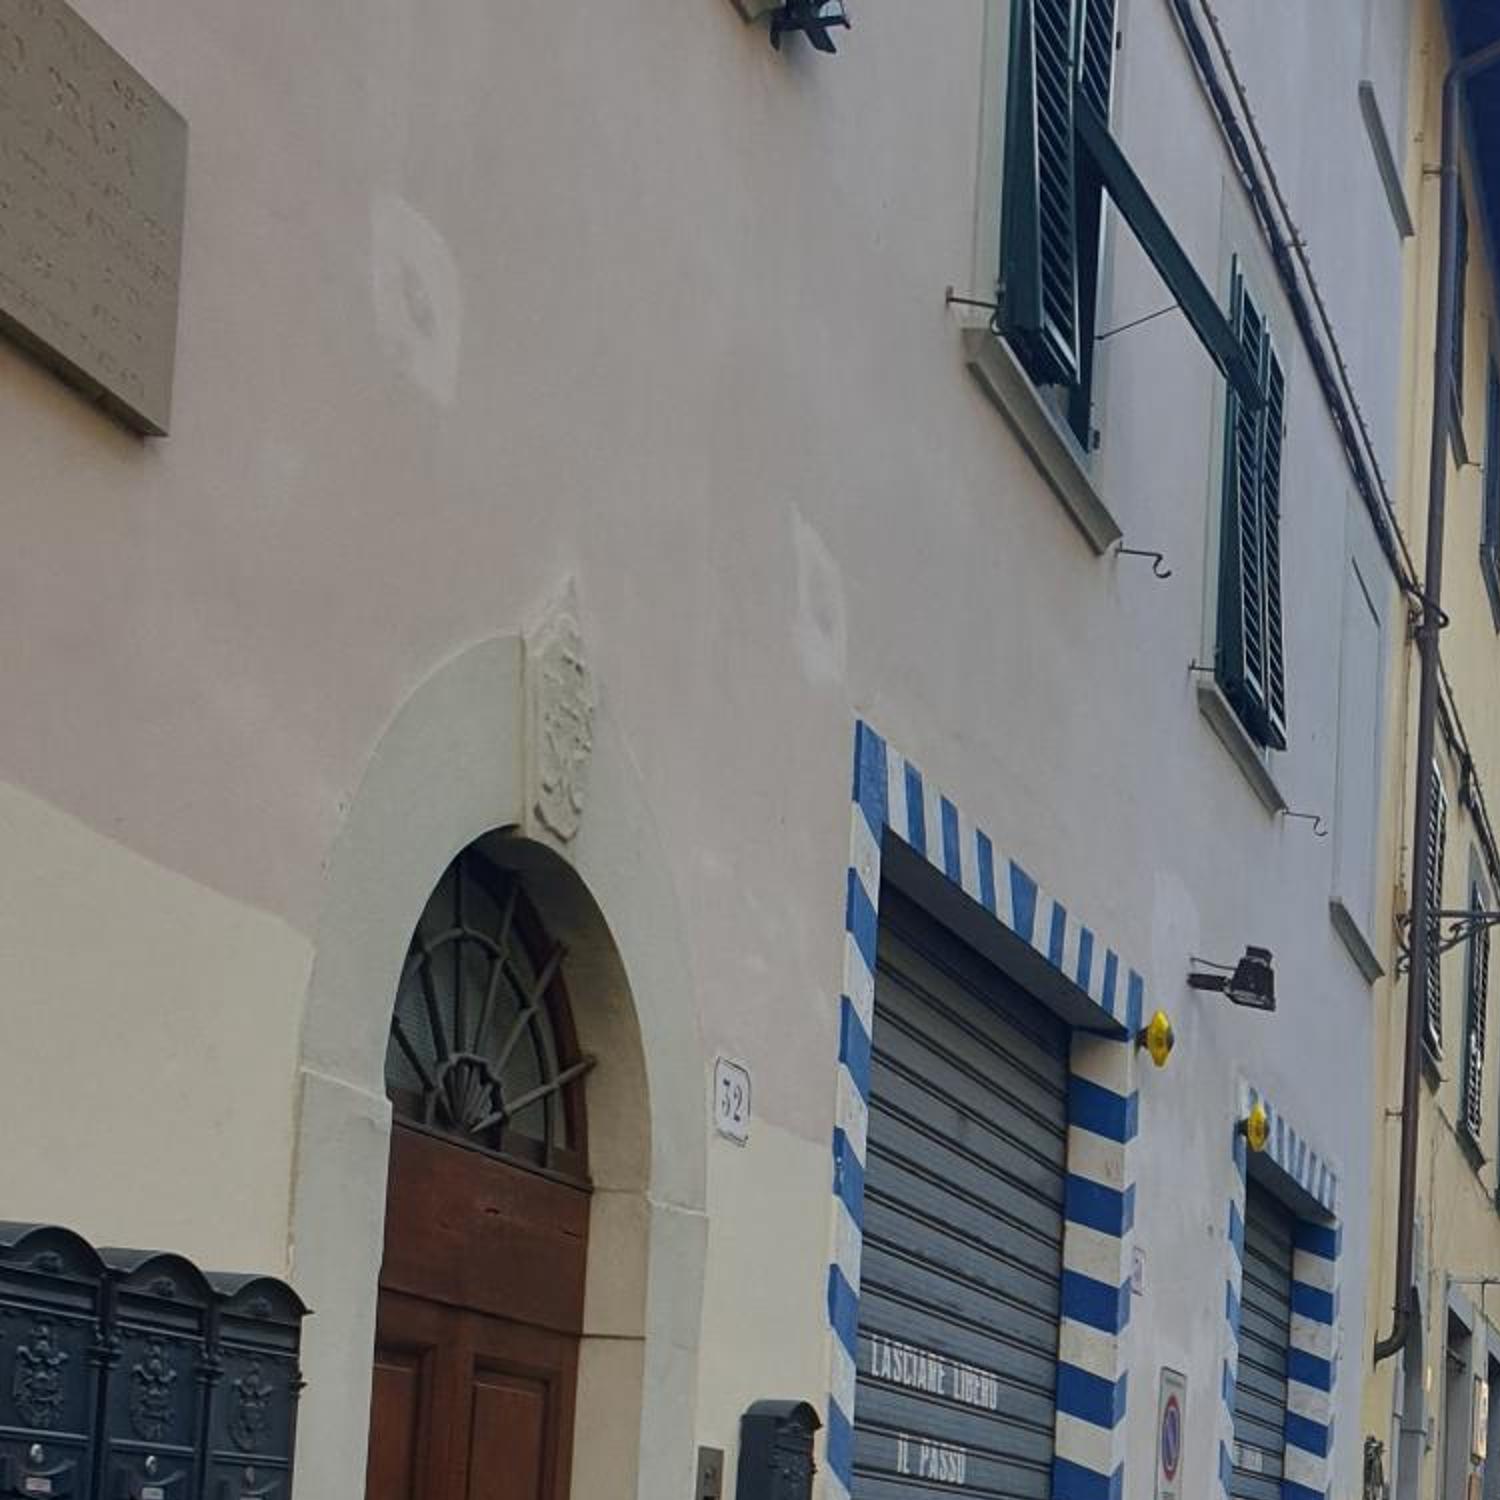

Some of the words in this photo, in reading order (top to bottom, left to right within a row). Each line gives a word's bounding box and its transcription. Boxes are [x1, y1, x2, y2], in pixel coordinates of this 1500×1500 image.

[722, 1077, 743, 1122] 32
[871, 1334, 945, 1395] LASCIARE
[953, 1361, 998, 1410] LIBERO
[897, 1434, 910, 1474] IL
[919, 1439, 966, 1484] PASSO
